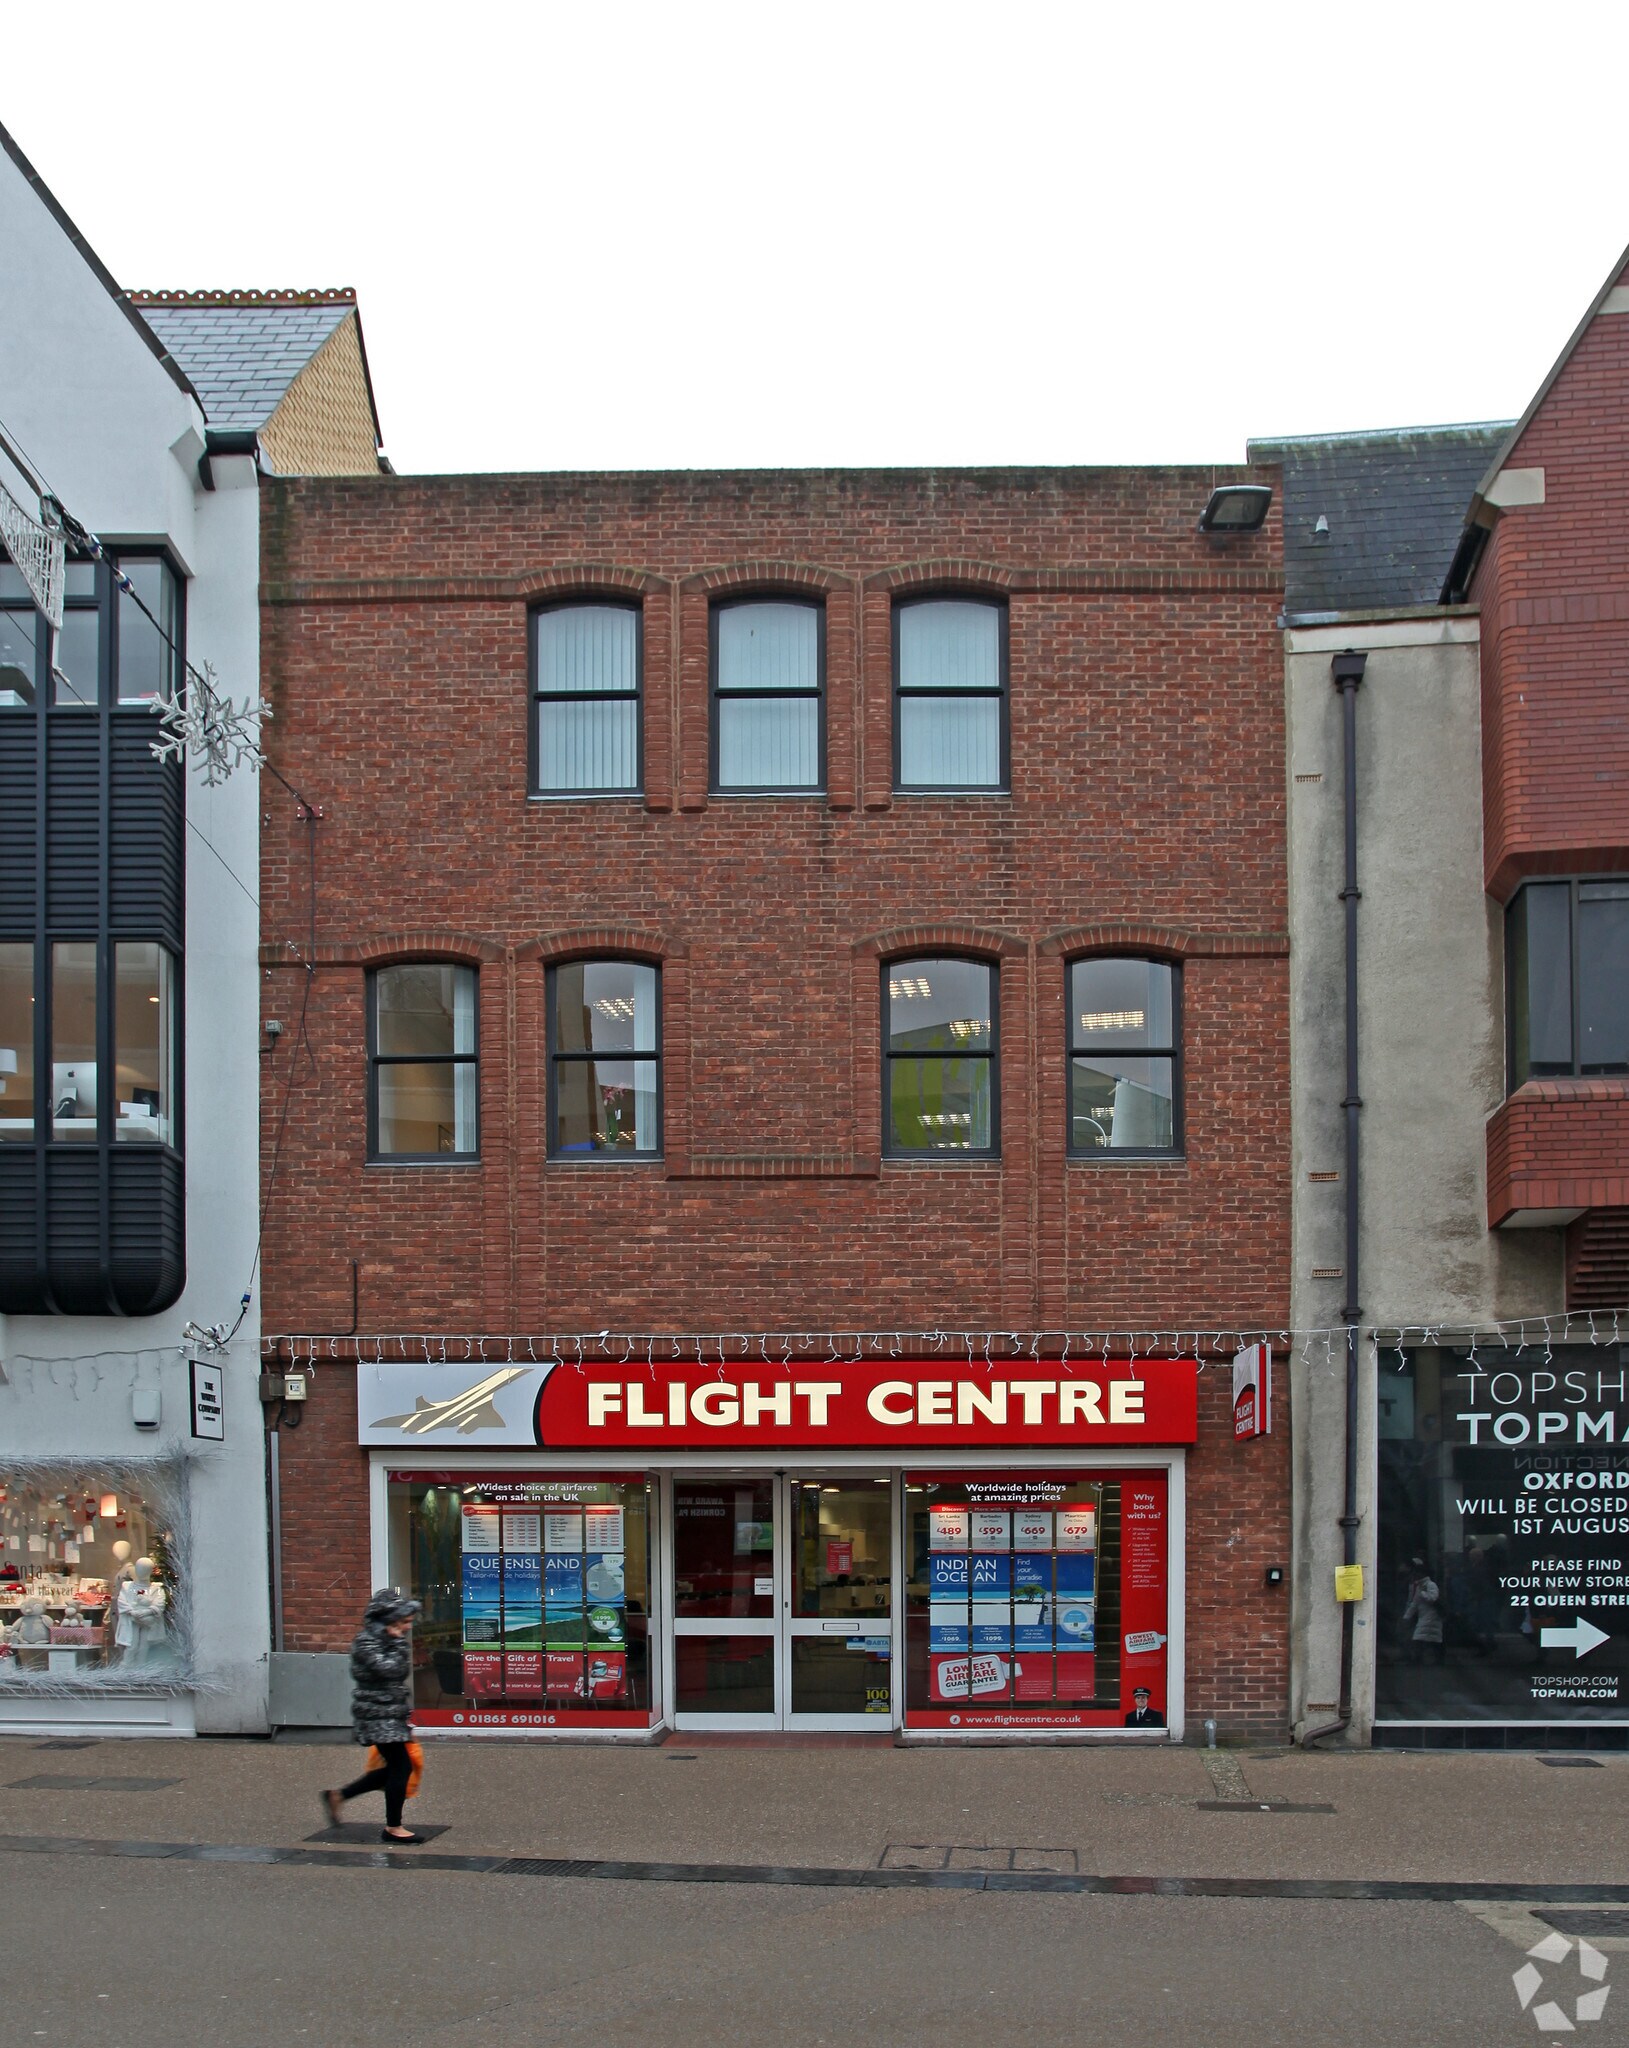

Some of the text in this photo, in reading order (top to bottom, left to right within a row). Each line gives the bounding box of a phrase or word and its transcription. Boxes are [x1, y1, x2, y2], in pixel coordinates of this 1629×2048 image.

[1457, 1371, 1624, 1405] TOPSH
[588, 1380, 1146, 1427] FLIGHT CENTRE
[1236, 1401, 1253, 1420] FLIGHT
[1236, 1416, 1253, 1435] CENTRE
[1456, 1410, 1629, 1445] TOPM
[1523, 1472, 1629, 1490] OXFORD
[477, 1483, 598, 1491] Widest choice of airfares
[965, 1482, 1067, 1494] Worldwide holidays
[510, 1493, 529, 1501] sale
[532, 1493, 541, 1501] in
[544, 1493, 560, 1501] the
[562, 1493, 579, 1501] UK
[971, 1493, 1061, 1503] at amazing prices
[1133, 1493, 1155, 1503] Why
[1456, 1497, 1628, 1514] WILL BE CLOSED
[936, 1527, 962, 1535] £489
[978, 1527, 1003, 1535] £599
[1020, 1526, 1045, 1535] £669
[1063, 1526, 1088, 1534] £679
[1513, 1517, 1629, 1534] 1ST AUGUS
[468, 1558, 580, 1570] QUEENSLAND
[936, 1559, 997, 1570] INDIAN
[1531, 1559, 1622, 1571] PLEASE FIND
[514, 1572, 541, 1580] holidays
[936, 1571, 997, 1582] OCEAN
[1016, 1574, 1043, 1582] paradise
[1499, 1576, 1629, 1588] YOUR NEW STORE
[1510, 1596, 1529, 1607] 22
[1534, 1595, 1586, 1606] QUEEN
[465, 1654, 575, 1662] Give the Gift of Travel
[945, 1676, 999, 1688] GUARANTEE
[1532, 1676, 1619, 1686] TOPSHOP.COM
[866, 1689, 889, 1700] 100
[1531, 1689, 1618, 1698] TOPMAN.COM
[469, 1715, 556, 1724] 01865 691016
[965, 1714, 1082, 1726] www.flightcentre.co.uk
